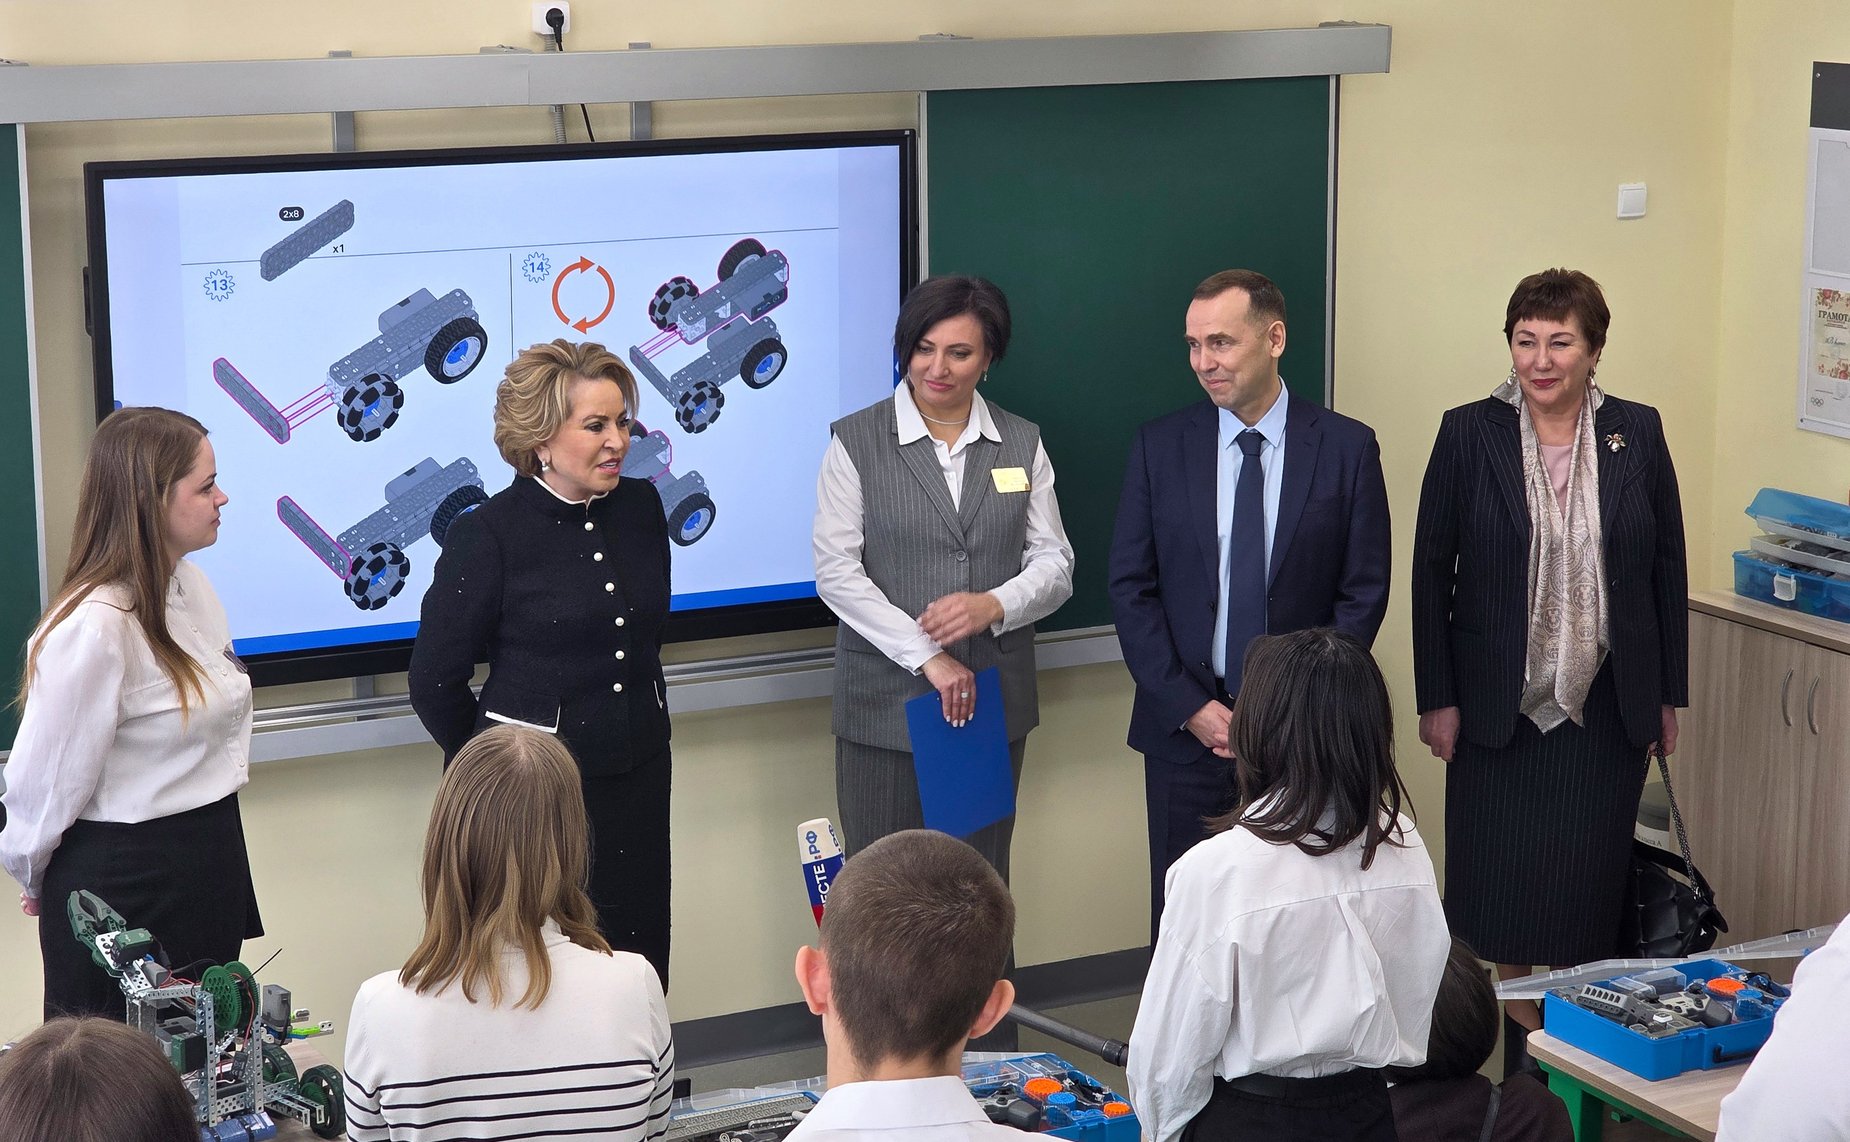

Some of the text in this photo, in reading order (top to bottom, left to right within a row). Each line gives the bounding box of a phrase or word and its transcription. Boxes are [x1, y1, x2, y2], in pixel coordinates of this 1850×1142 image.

[283, 209, 300, 219] 2x8
[333, 244, 344, 253] x1
[529, 261, 545, 273] 14
[211, 279, 228, 291] 13
